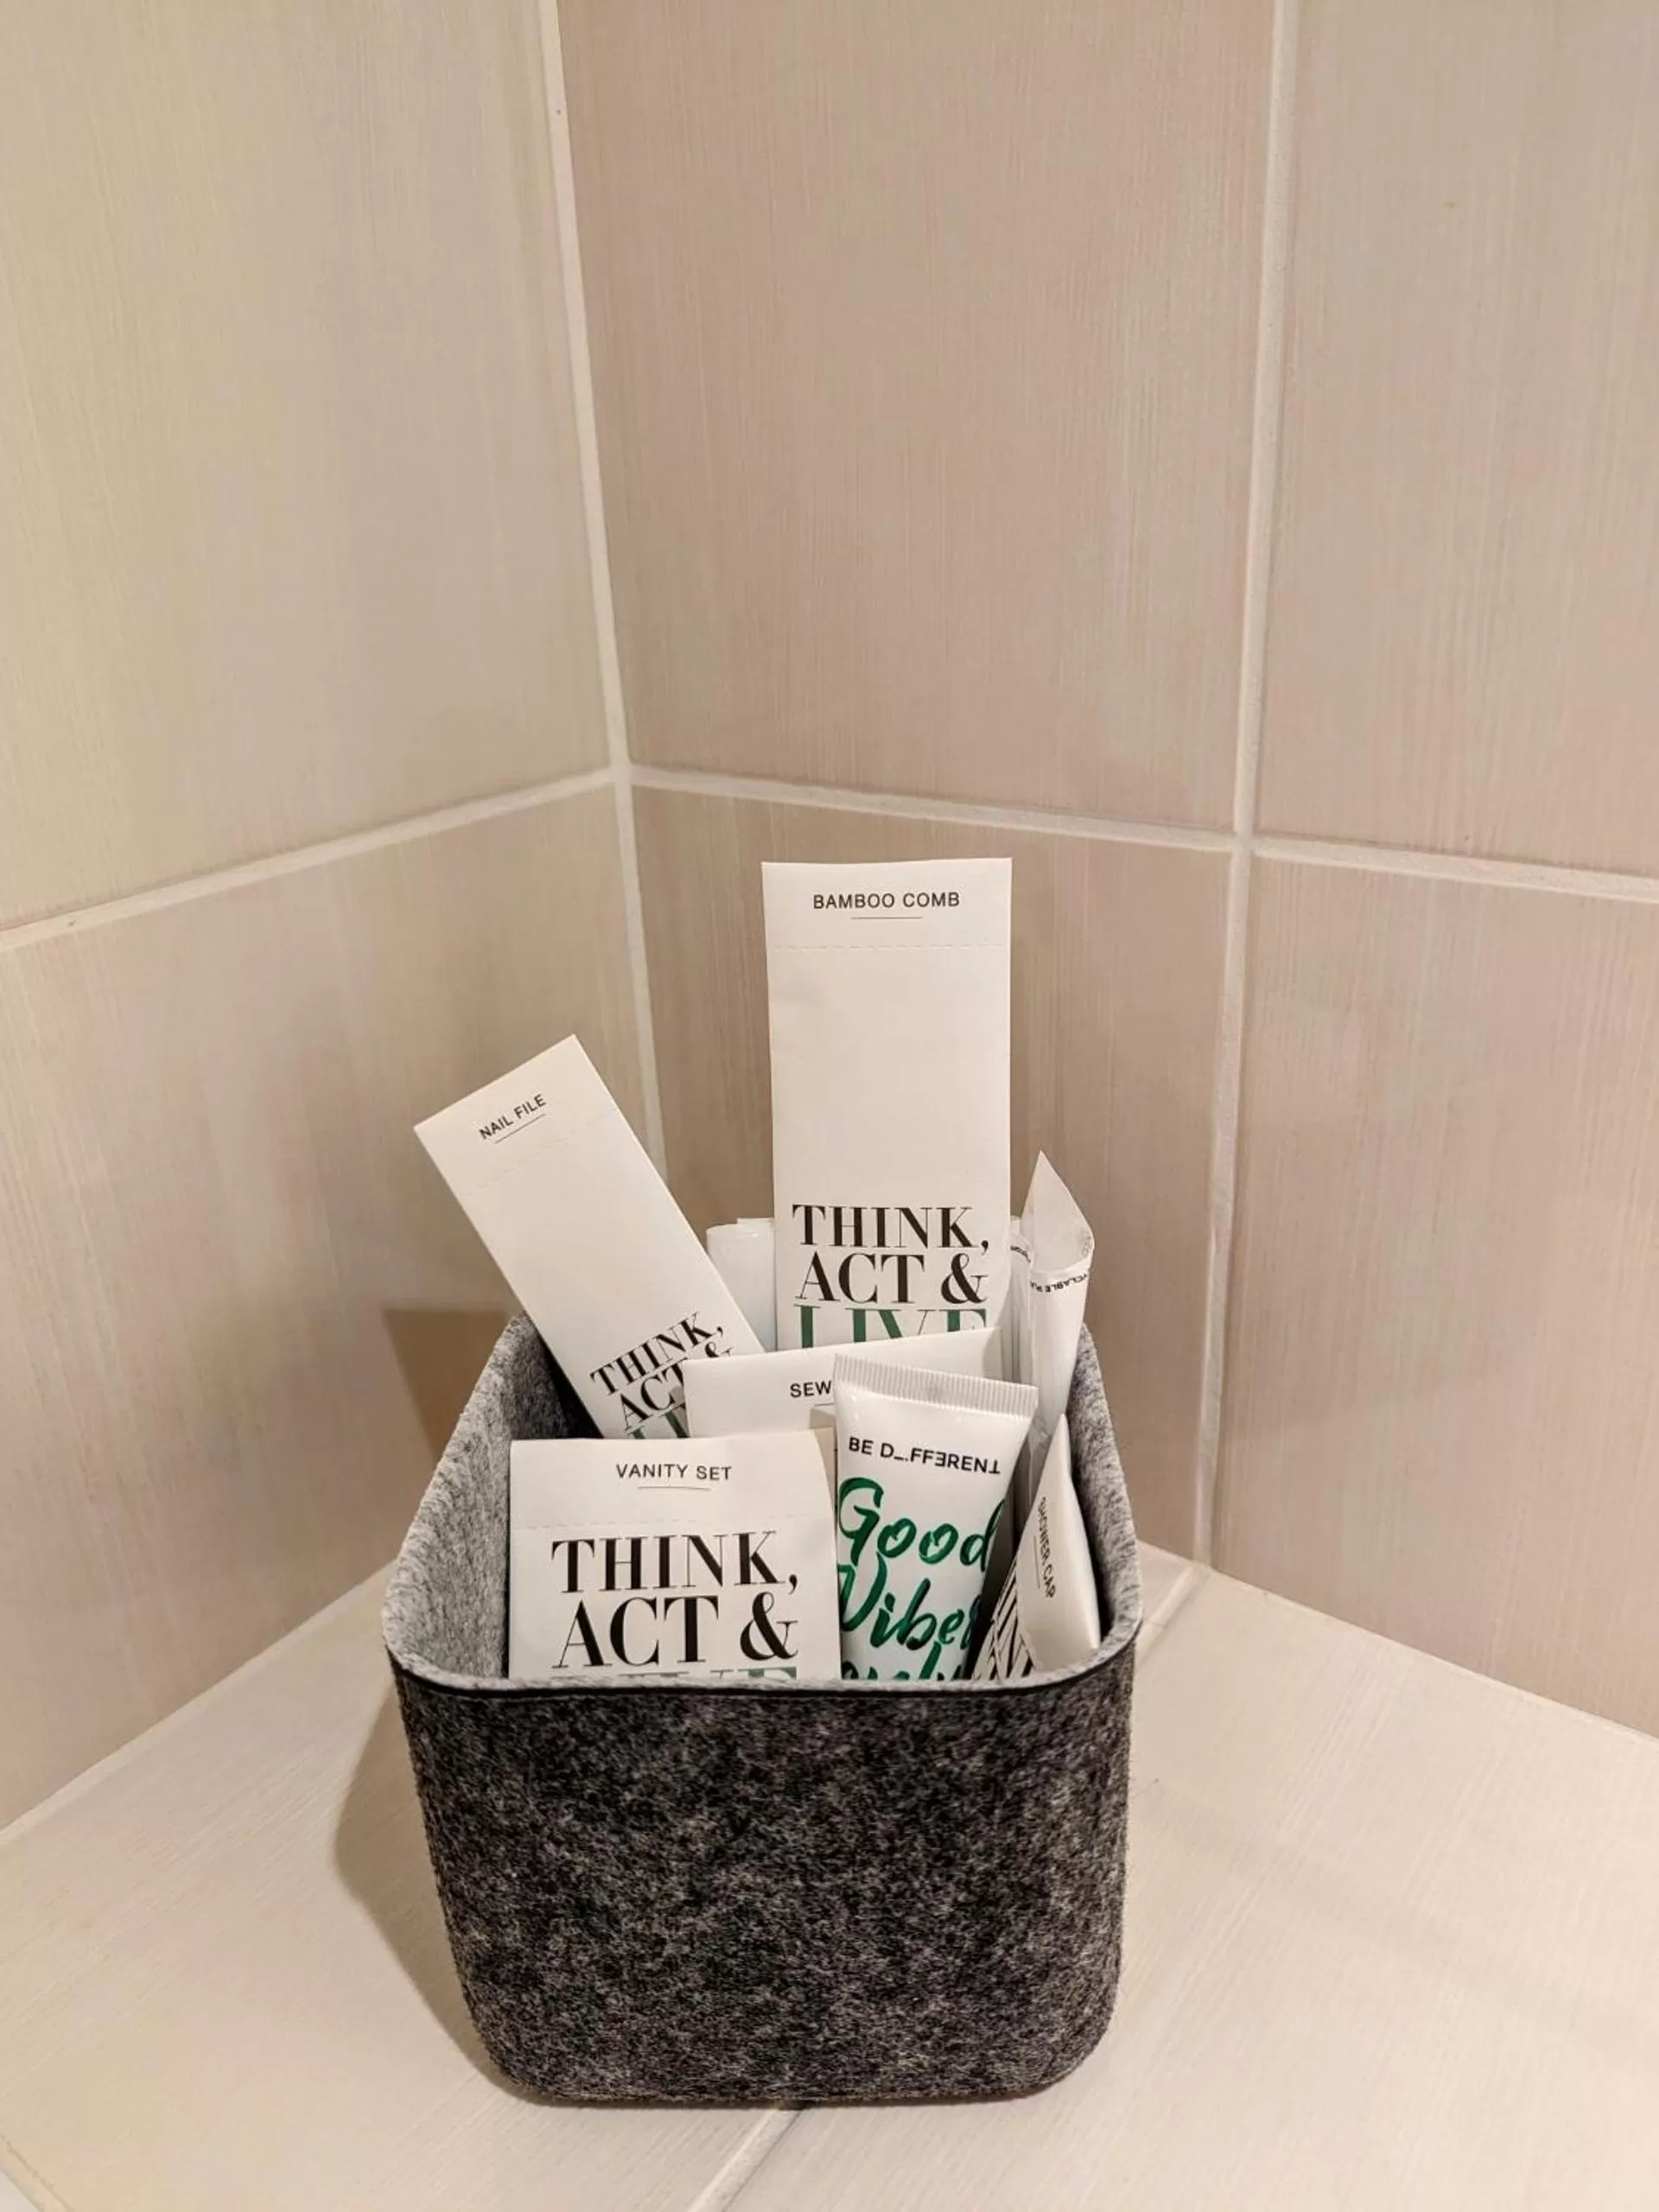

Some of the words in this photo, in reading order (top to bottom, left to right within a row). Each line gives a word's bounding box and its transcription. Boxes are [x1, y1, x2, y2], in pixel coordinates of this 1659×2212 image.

[813, 893, 895, 909] BAMBOO
[902, 892, 960, 908] COMB
[479, 1115, 514, 1140] NAIL
[514, 1094, 546, 1119] FILE
[791, 1204, 989, 1255] THINK,
[794, 1251, 925, 1304] ACT
[940, 1253, 988, 1304] &
[589, 1311, 724, 1396] THINK,
[849, 1436, 874, 1455] BE
[616, 1464, 689, 1479] VANITY
[696, 1465, 733, 1481] SET
[838, 1476, 1006, 1573] Good
[550, 1530, 798, 1595] THINK,
[1043, 1563, 1057, 1599] CAP
[551, 1594, 719, 1669] ACT
[739, 1591, 799, 1662] &
